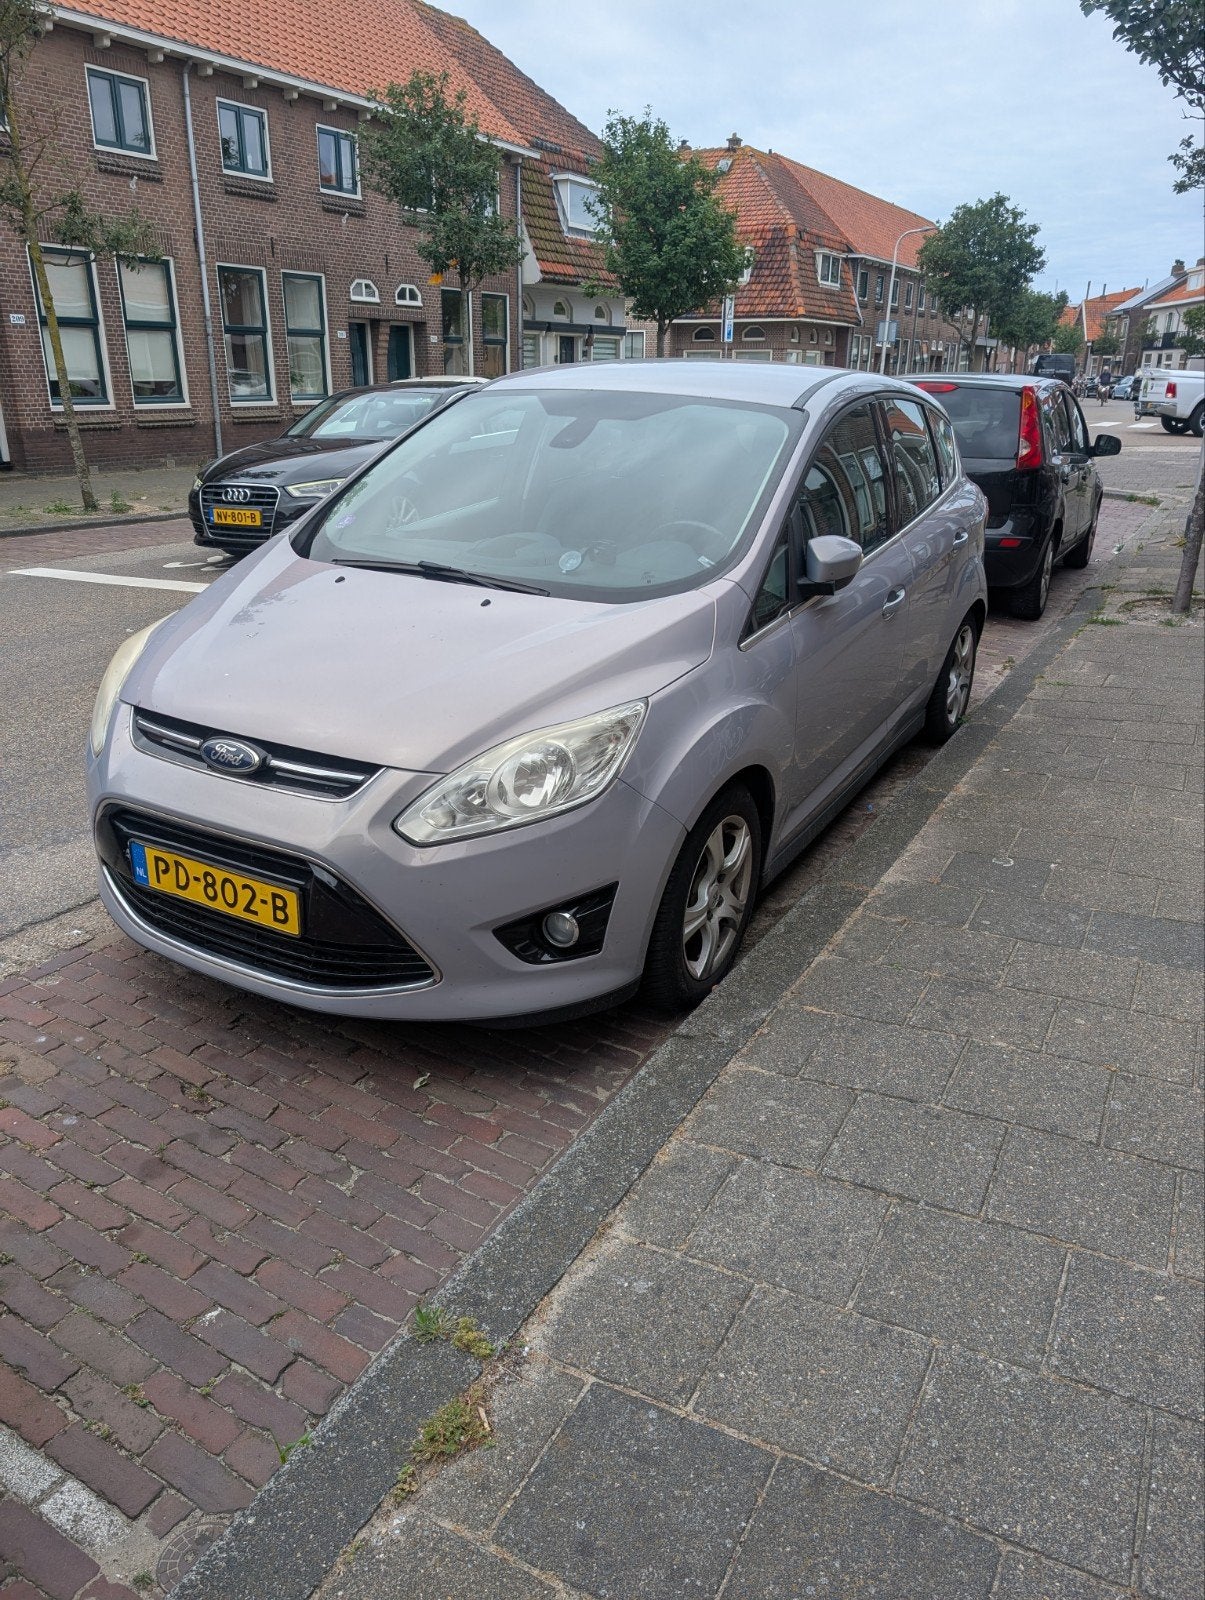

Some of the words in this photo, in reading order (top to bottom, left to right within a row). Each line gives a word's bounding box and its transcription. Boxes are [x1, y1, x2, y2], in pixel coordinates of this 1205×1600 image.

[216, 511, 256, 523] NV-801-B
[210, 743, 243, 766] Ford
[136, 867, 147, 878] NL
[154, 855, 288, 924] PD-802-B
